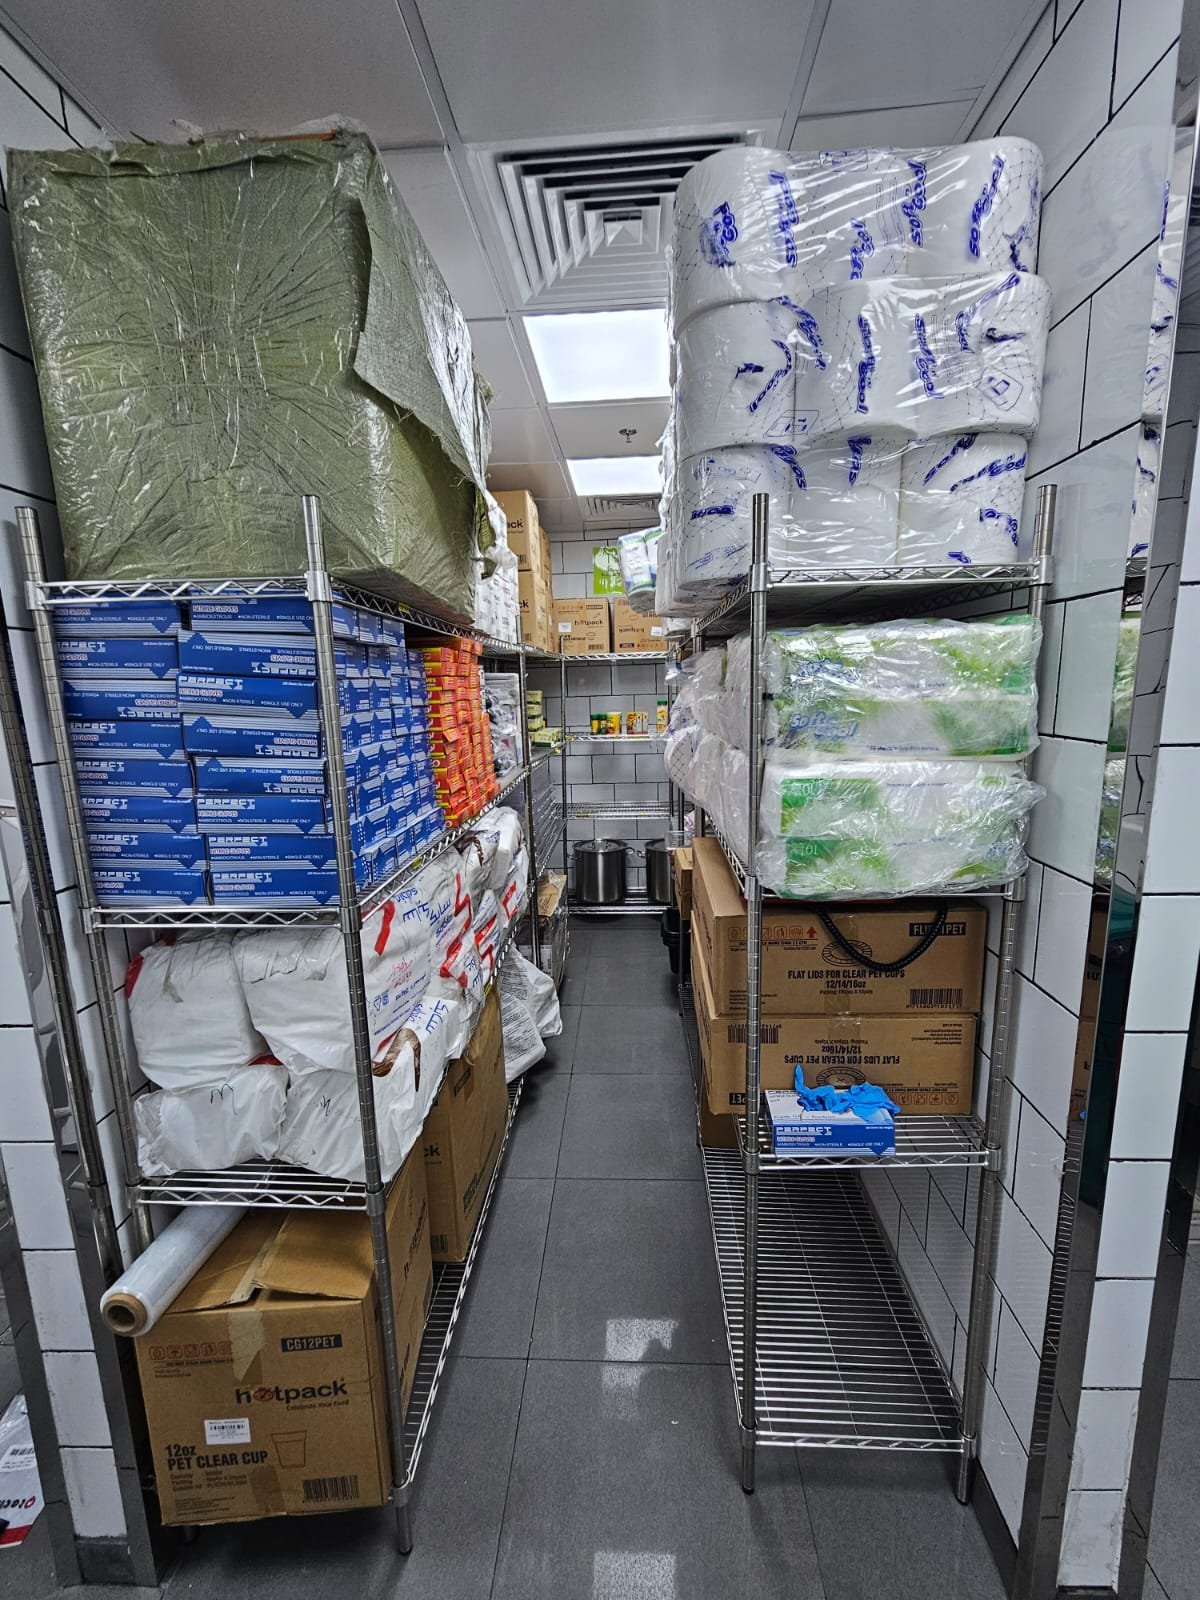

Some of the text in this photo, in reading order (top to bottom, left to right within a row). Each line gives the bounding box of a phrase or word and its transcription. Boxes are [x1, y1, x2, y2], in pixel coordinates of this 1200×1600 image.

[179, 676, 243, 687] PERFECT
[788, 970, 905, 979] FLAT LIDS FOR CLEAR PET CUPS
[826, 980, 866, 988] 12/14/16oz
[822, 1045, 862, 1054] 12/14/16oz
[785, 1055, 899, 1064] FLAT LIDS FOR CLEAR PET CUPS
[776, 1127, 832, 1135] PERFECT
[286, 1336, 336, 1350] CG12PET
[236, 1380, 348, 1404] hotpack
[166, 1445, 196, 1457] 12oz
[168, 1450, 268, 1471] PET CLEAR CUP
